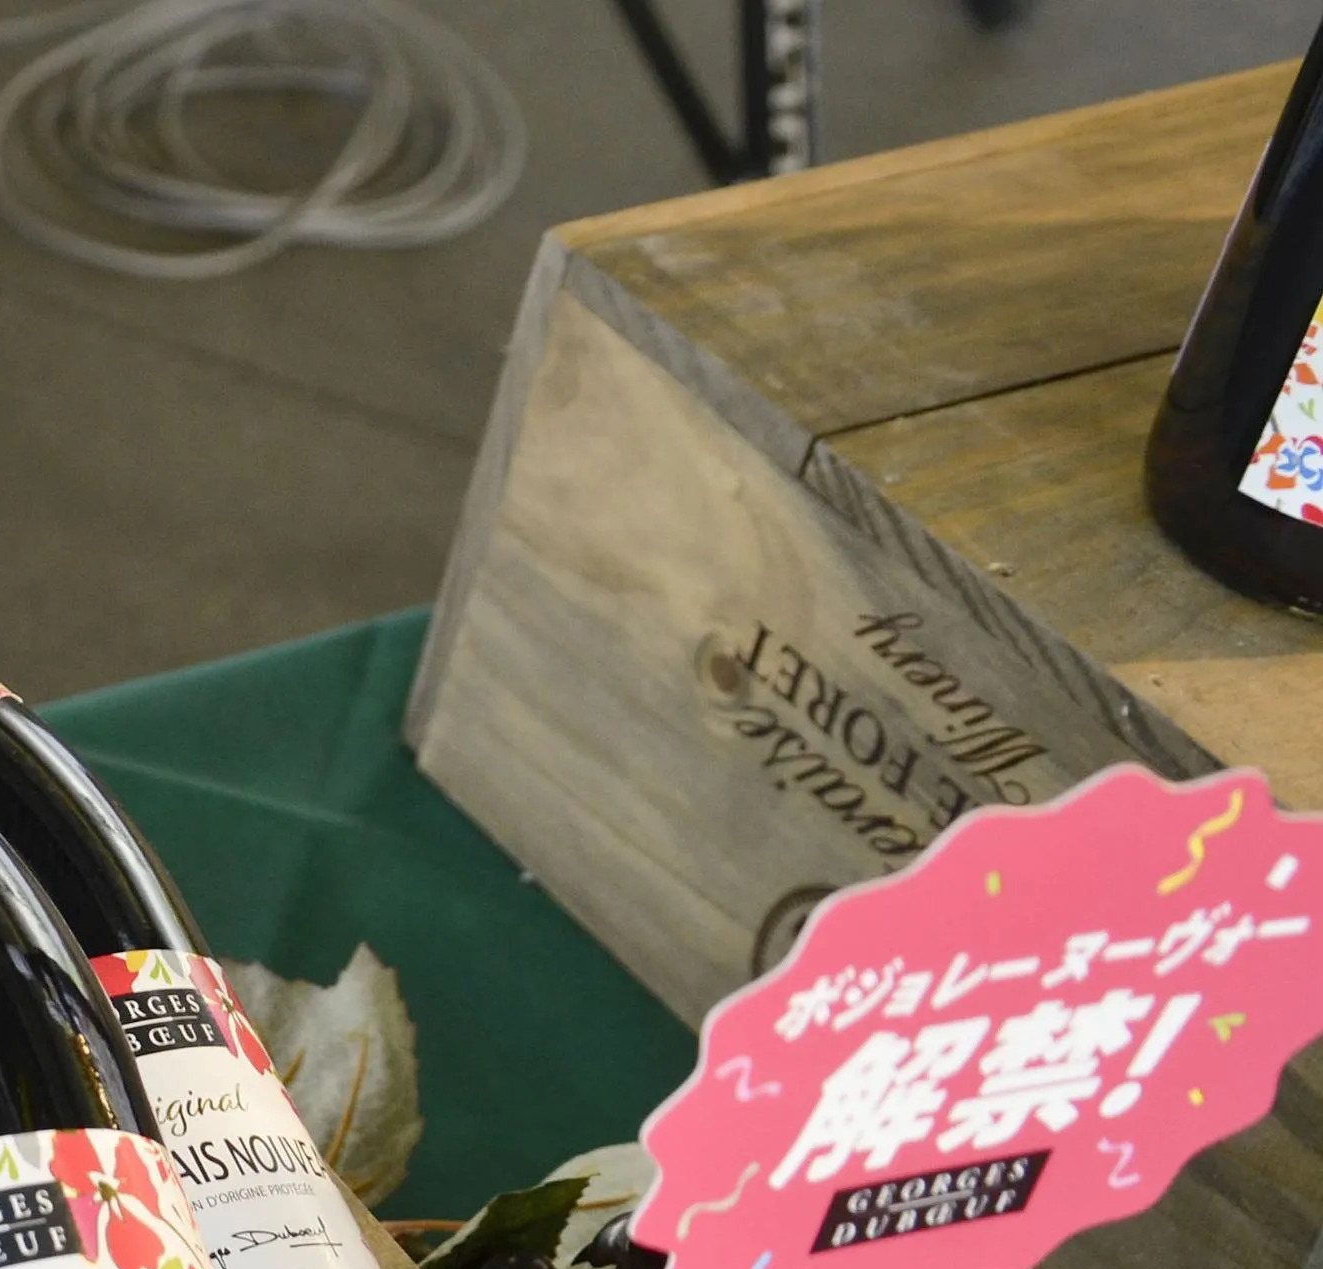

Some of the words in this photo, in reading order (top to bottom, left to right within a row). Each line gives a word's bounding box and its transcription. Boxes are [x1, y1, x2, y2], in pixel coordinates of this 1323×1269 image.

[735, 620, 919, 798] FORET
[855, 610, 1051, 806] Winery
[847, 1157, 1029, 1214] GEORGES
